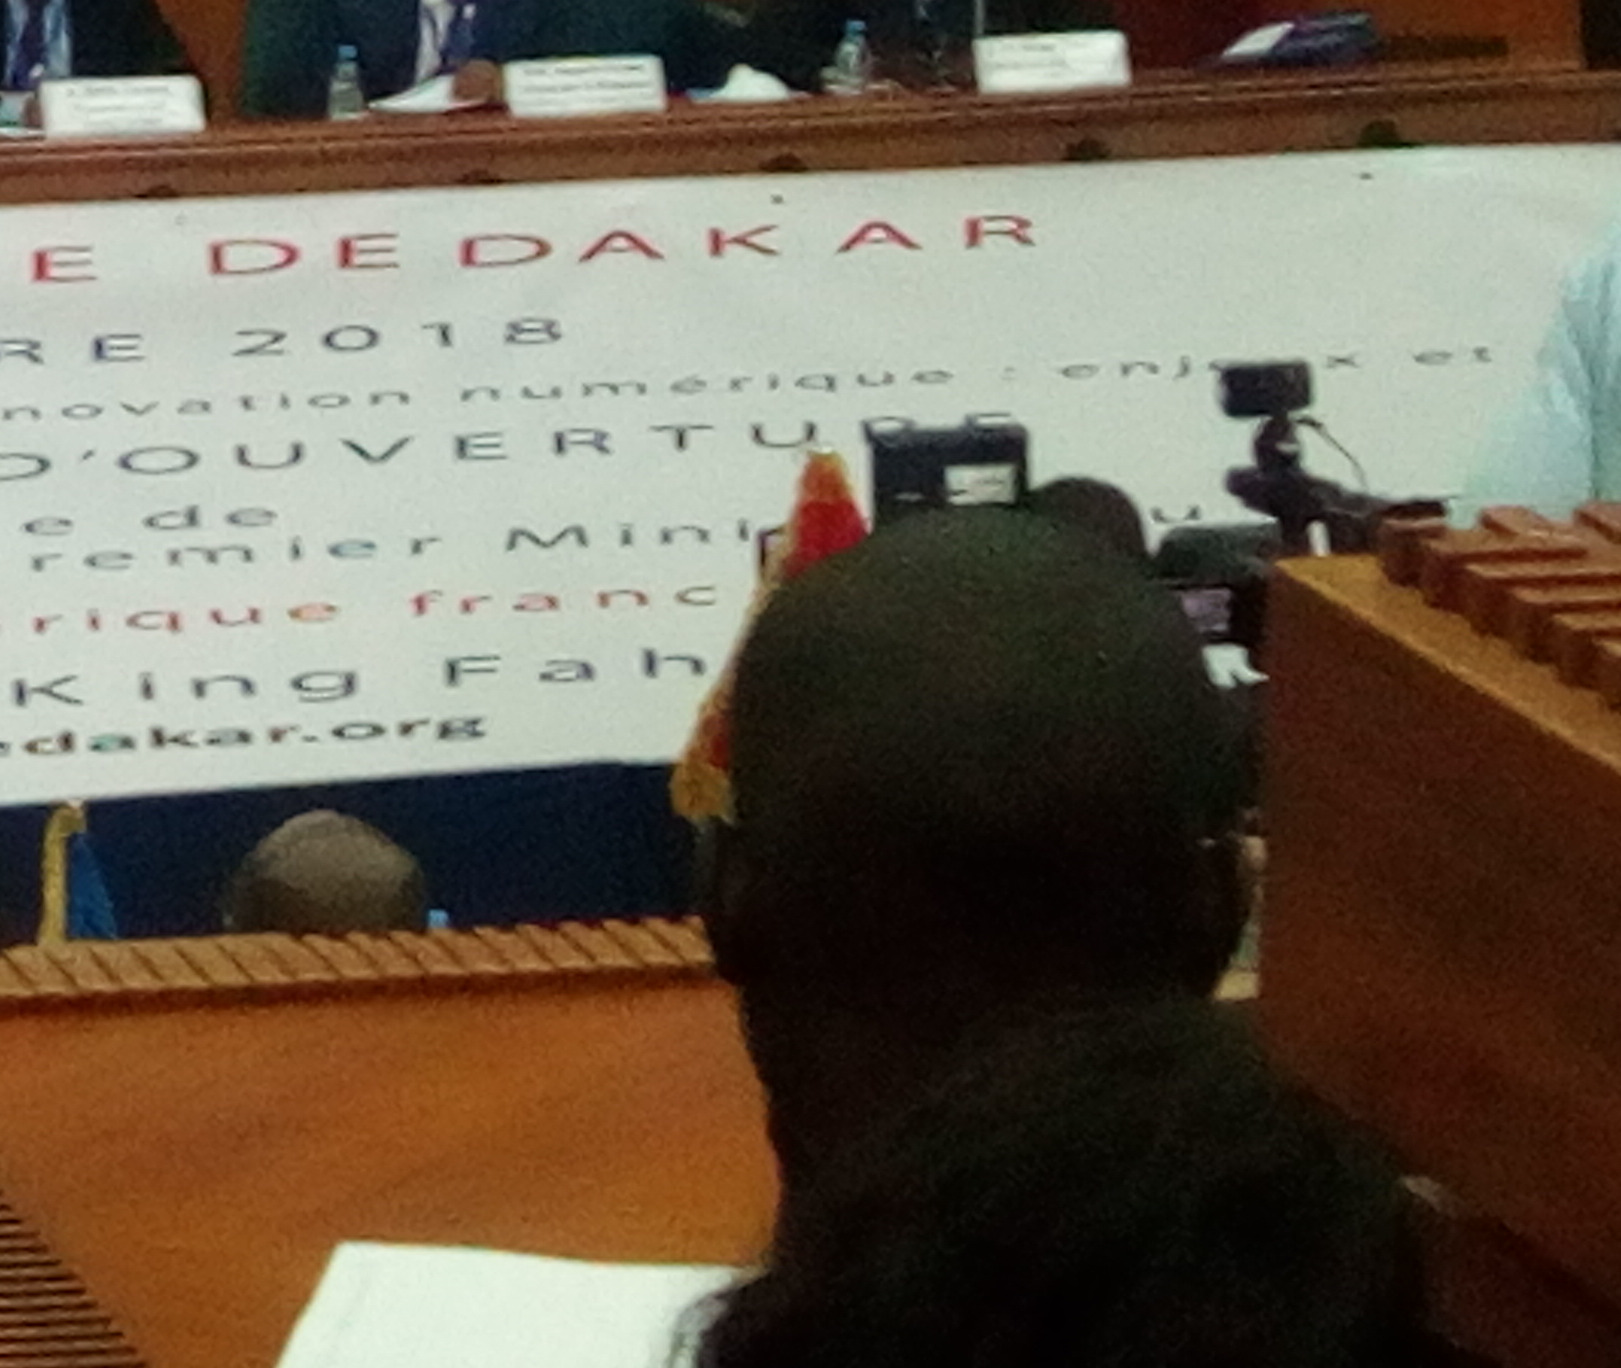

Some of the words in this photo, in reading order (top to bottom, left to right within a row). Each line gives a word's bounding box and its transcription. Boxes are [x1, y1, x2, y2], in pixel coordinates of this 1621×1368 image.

[207, 214, 1036, 275] DEDAKAR
[232, 316, 561, 357] 2018
[460, 369, 954, 402] numérique
[1412, 345, 1493, 368] et
[141, 505, 278, 531] de
[13, 670, 357, 707] King
[445, 649, 706, 687] Fah
